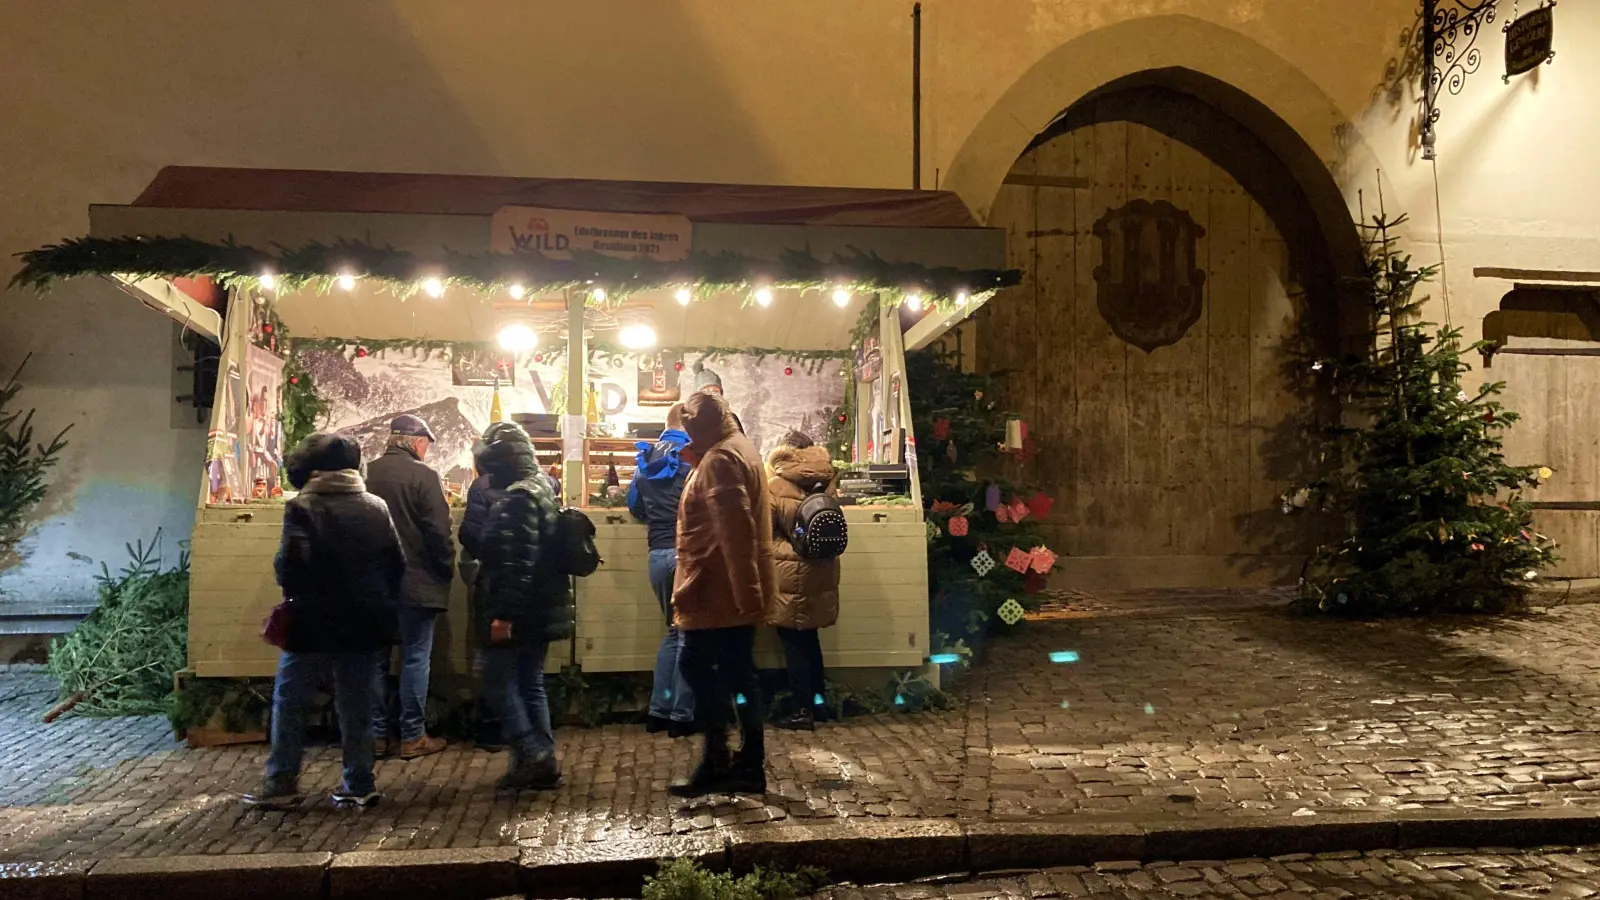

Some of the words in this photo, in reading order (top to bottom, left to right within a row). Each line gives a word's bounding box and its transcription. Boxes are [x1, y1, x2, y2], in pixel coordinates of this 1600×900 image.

[508, 224, 570, 251] WILD
[631, 229, 648, 240] des
[650, 230, 680, 242] Jahres
